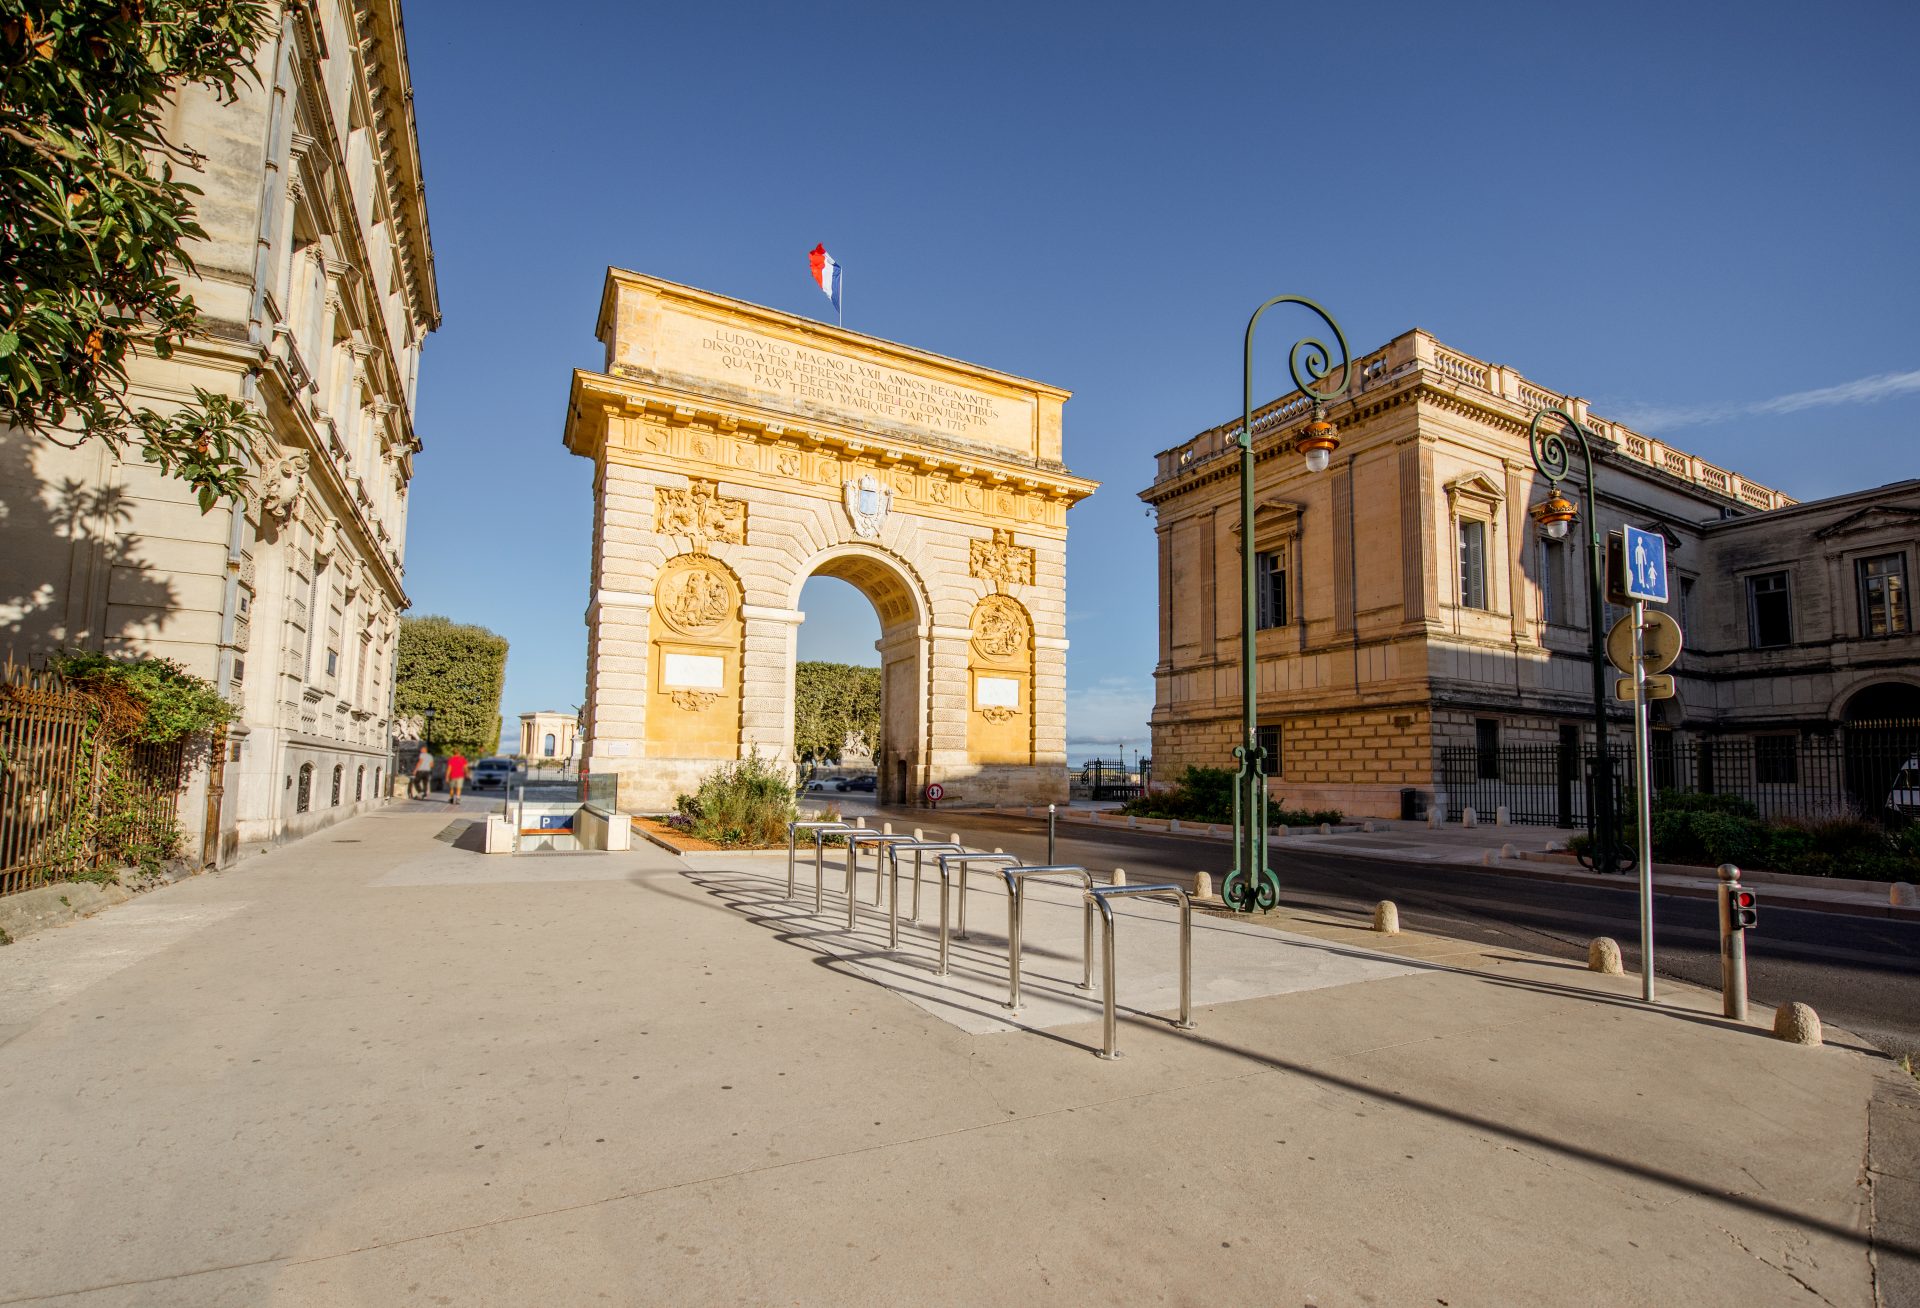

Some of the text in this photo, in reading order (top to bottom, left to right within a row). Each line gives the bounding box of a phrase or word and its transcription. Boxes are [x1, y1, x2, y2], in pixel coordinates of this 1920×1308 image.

[703, 338, 999, 419] DISSOCIATIS REPRESSIS CONCILIATIS GENTIBUS
[716, 330, 993, 408] LUDOVICO MAGNO LXXII ANNOS REGNANTE
[722, 355, 793, 381] QUATUOR
[877, 392, 914, 409] BELLO
[920, 403, 987, 426] CONJURATIS
[754, 374, 967, 432] PAX TERRA MARIQUE PARTA 1715
[542, 817, 551, 828] P
